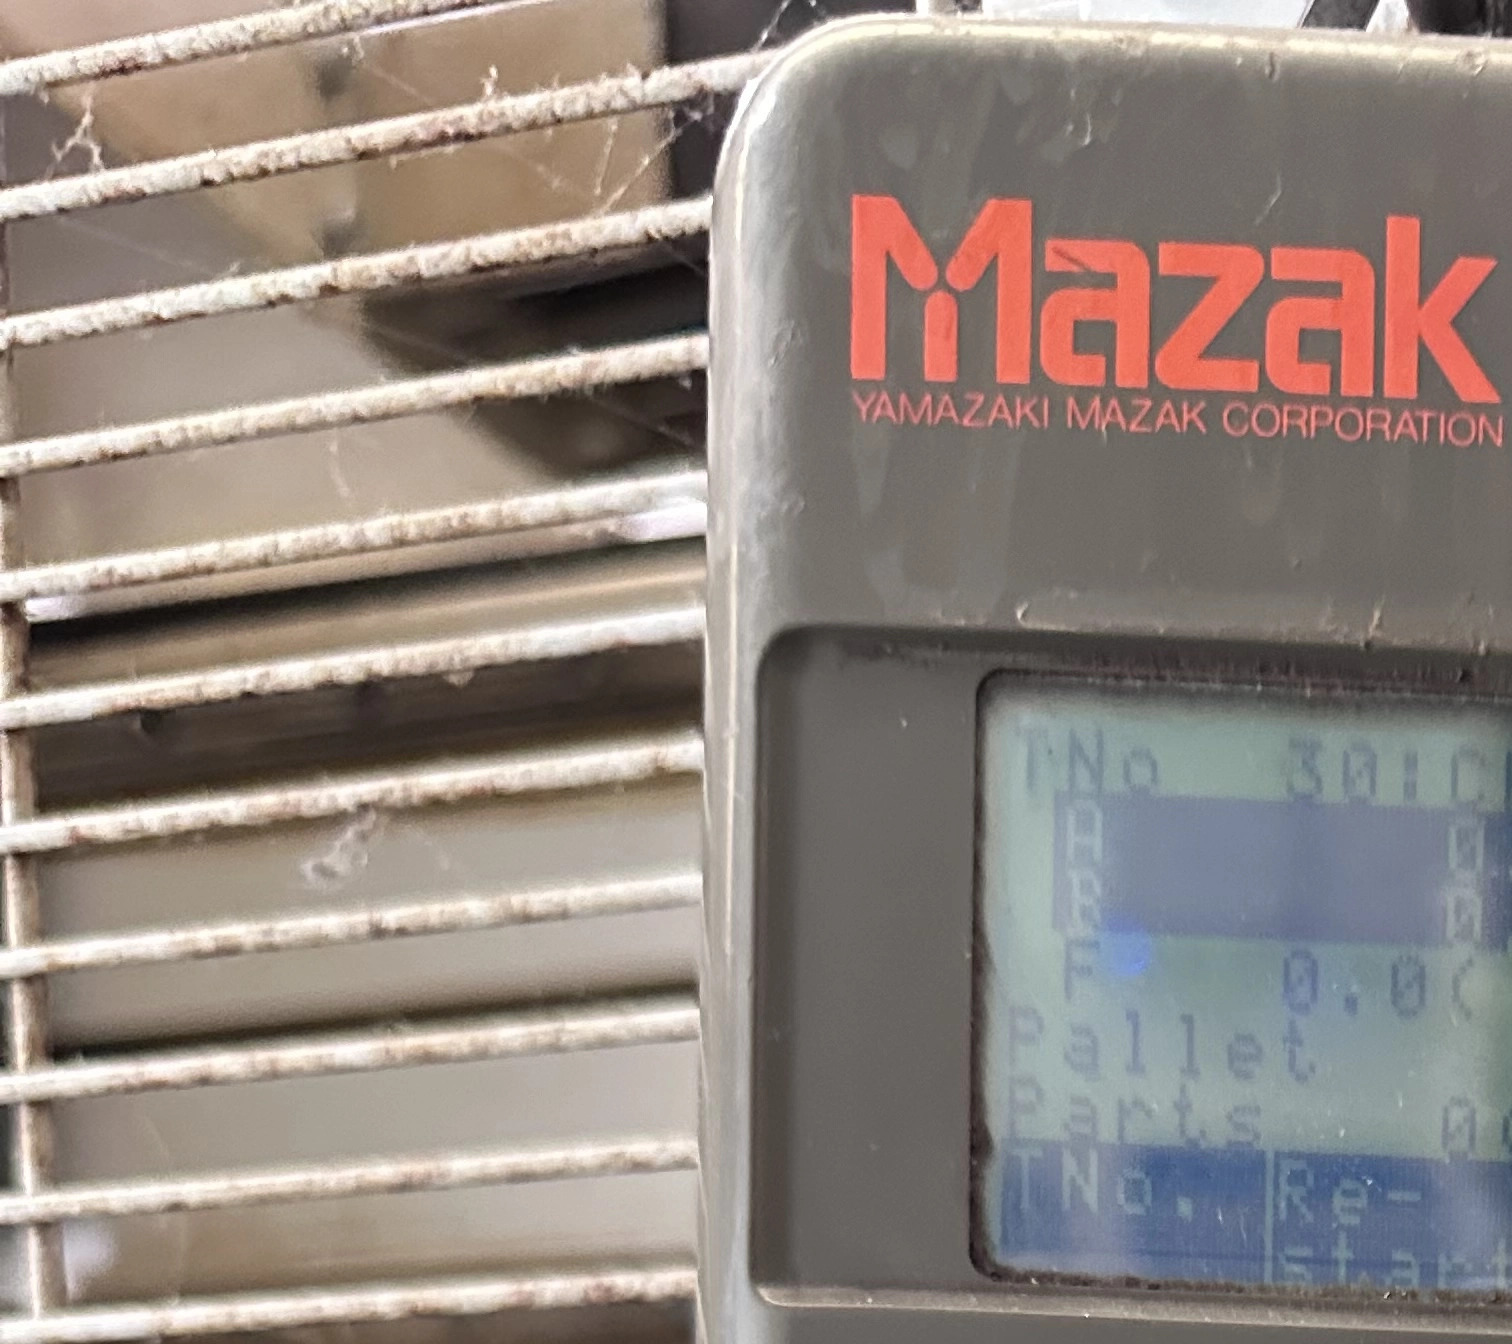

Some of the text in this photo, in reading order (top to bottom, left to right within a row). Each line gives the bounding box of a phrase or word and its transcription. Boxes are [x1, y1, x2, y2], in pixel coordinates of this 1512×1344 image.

[851, 194, 1501, 404] Mazak
[853, 391, 1503, 446] YAMAZAKI MAZAK CORPORATION
[1007, 1004, 1317, 1083] Pallet
[1007, 1075, 1263, 1148] Parts
